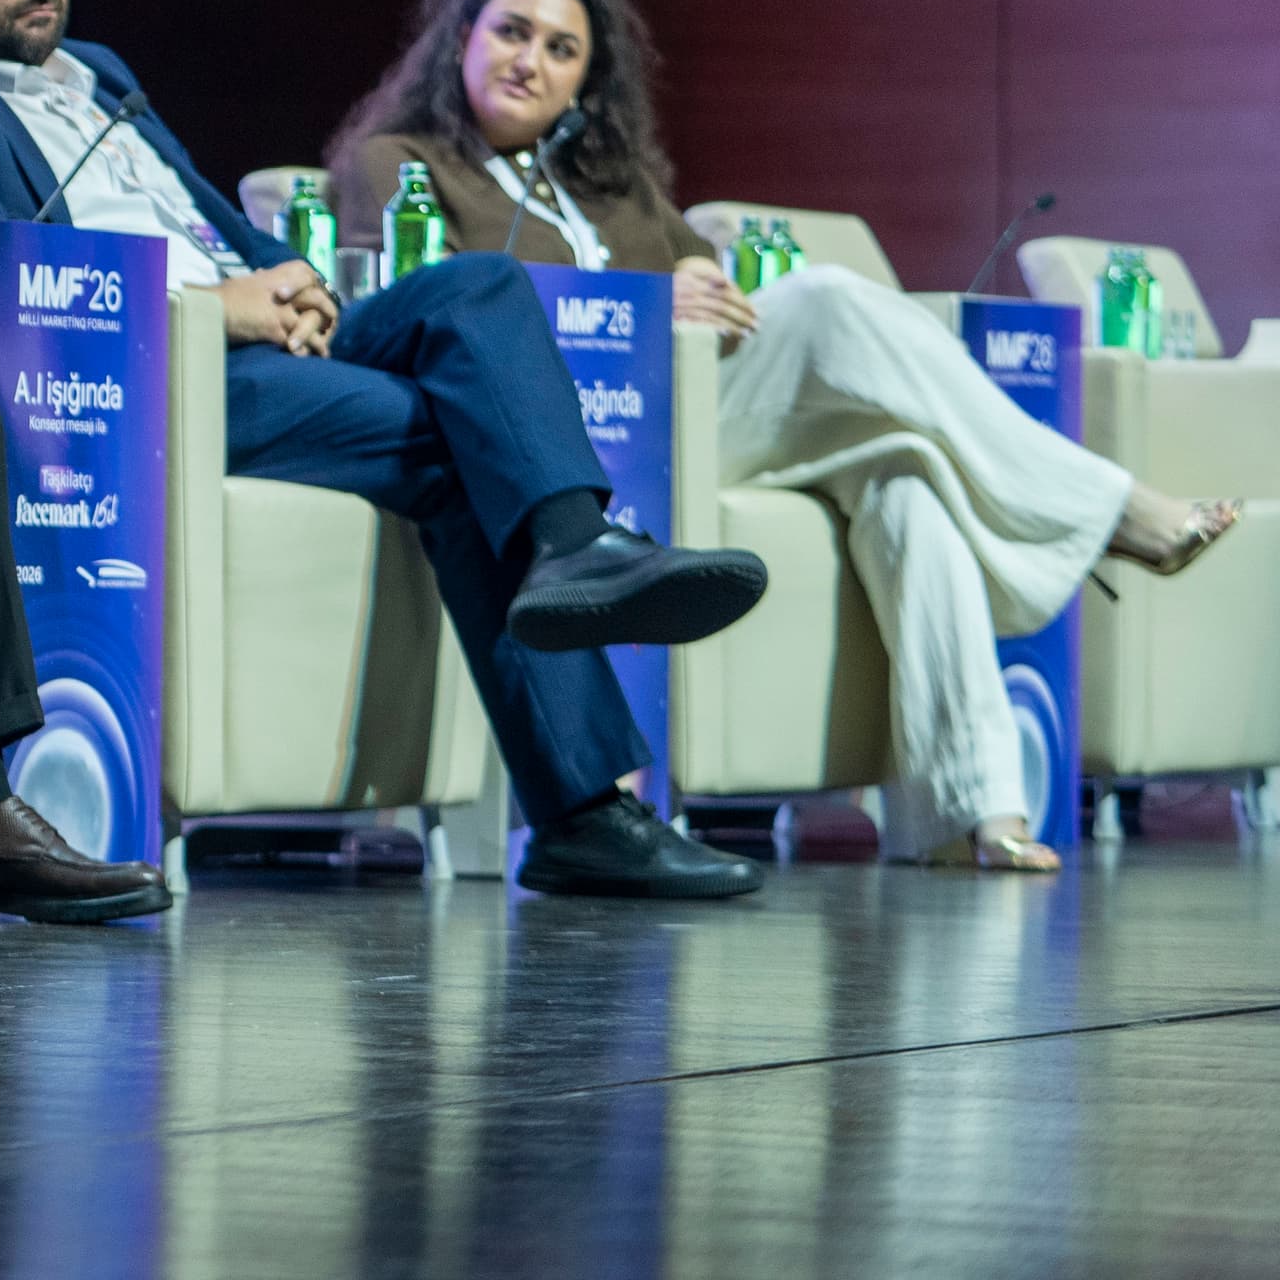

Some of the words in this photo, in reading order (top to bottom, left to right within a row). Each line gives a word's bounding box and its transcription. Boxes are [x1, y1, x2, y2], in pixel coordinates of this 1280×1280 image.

[14, 371, 42, 404] A.I
[47, 372, 123, 416] işığında
[15, 494, 90, 527] facemark
[16, 565, 43, 584] 2026
